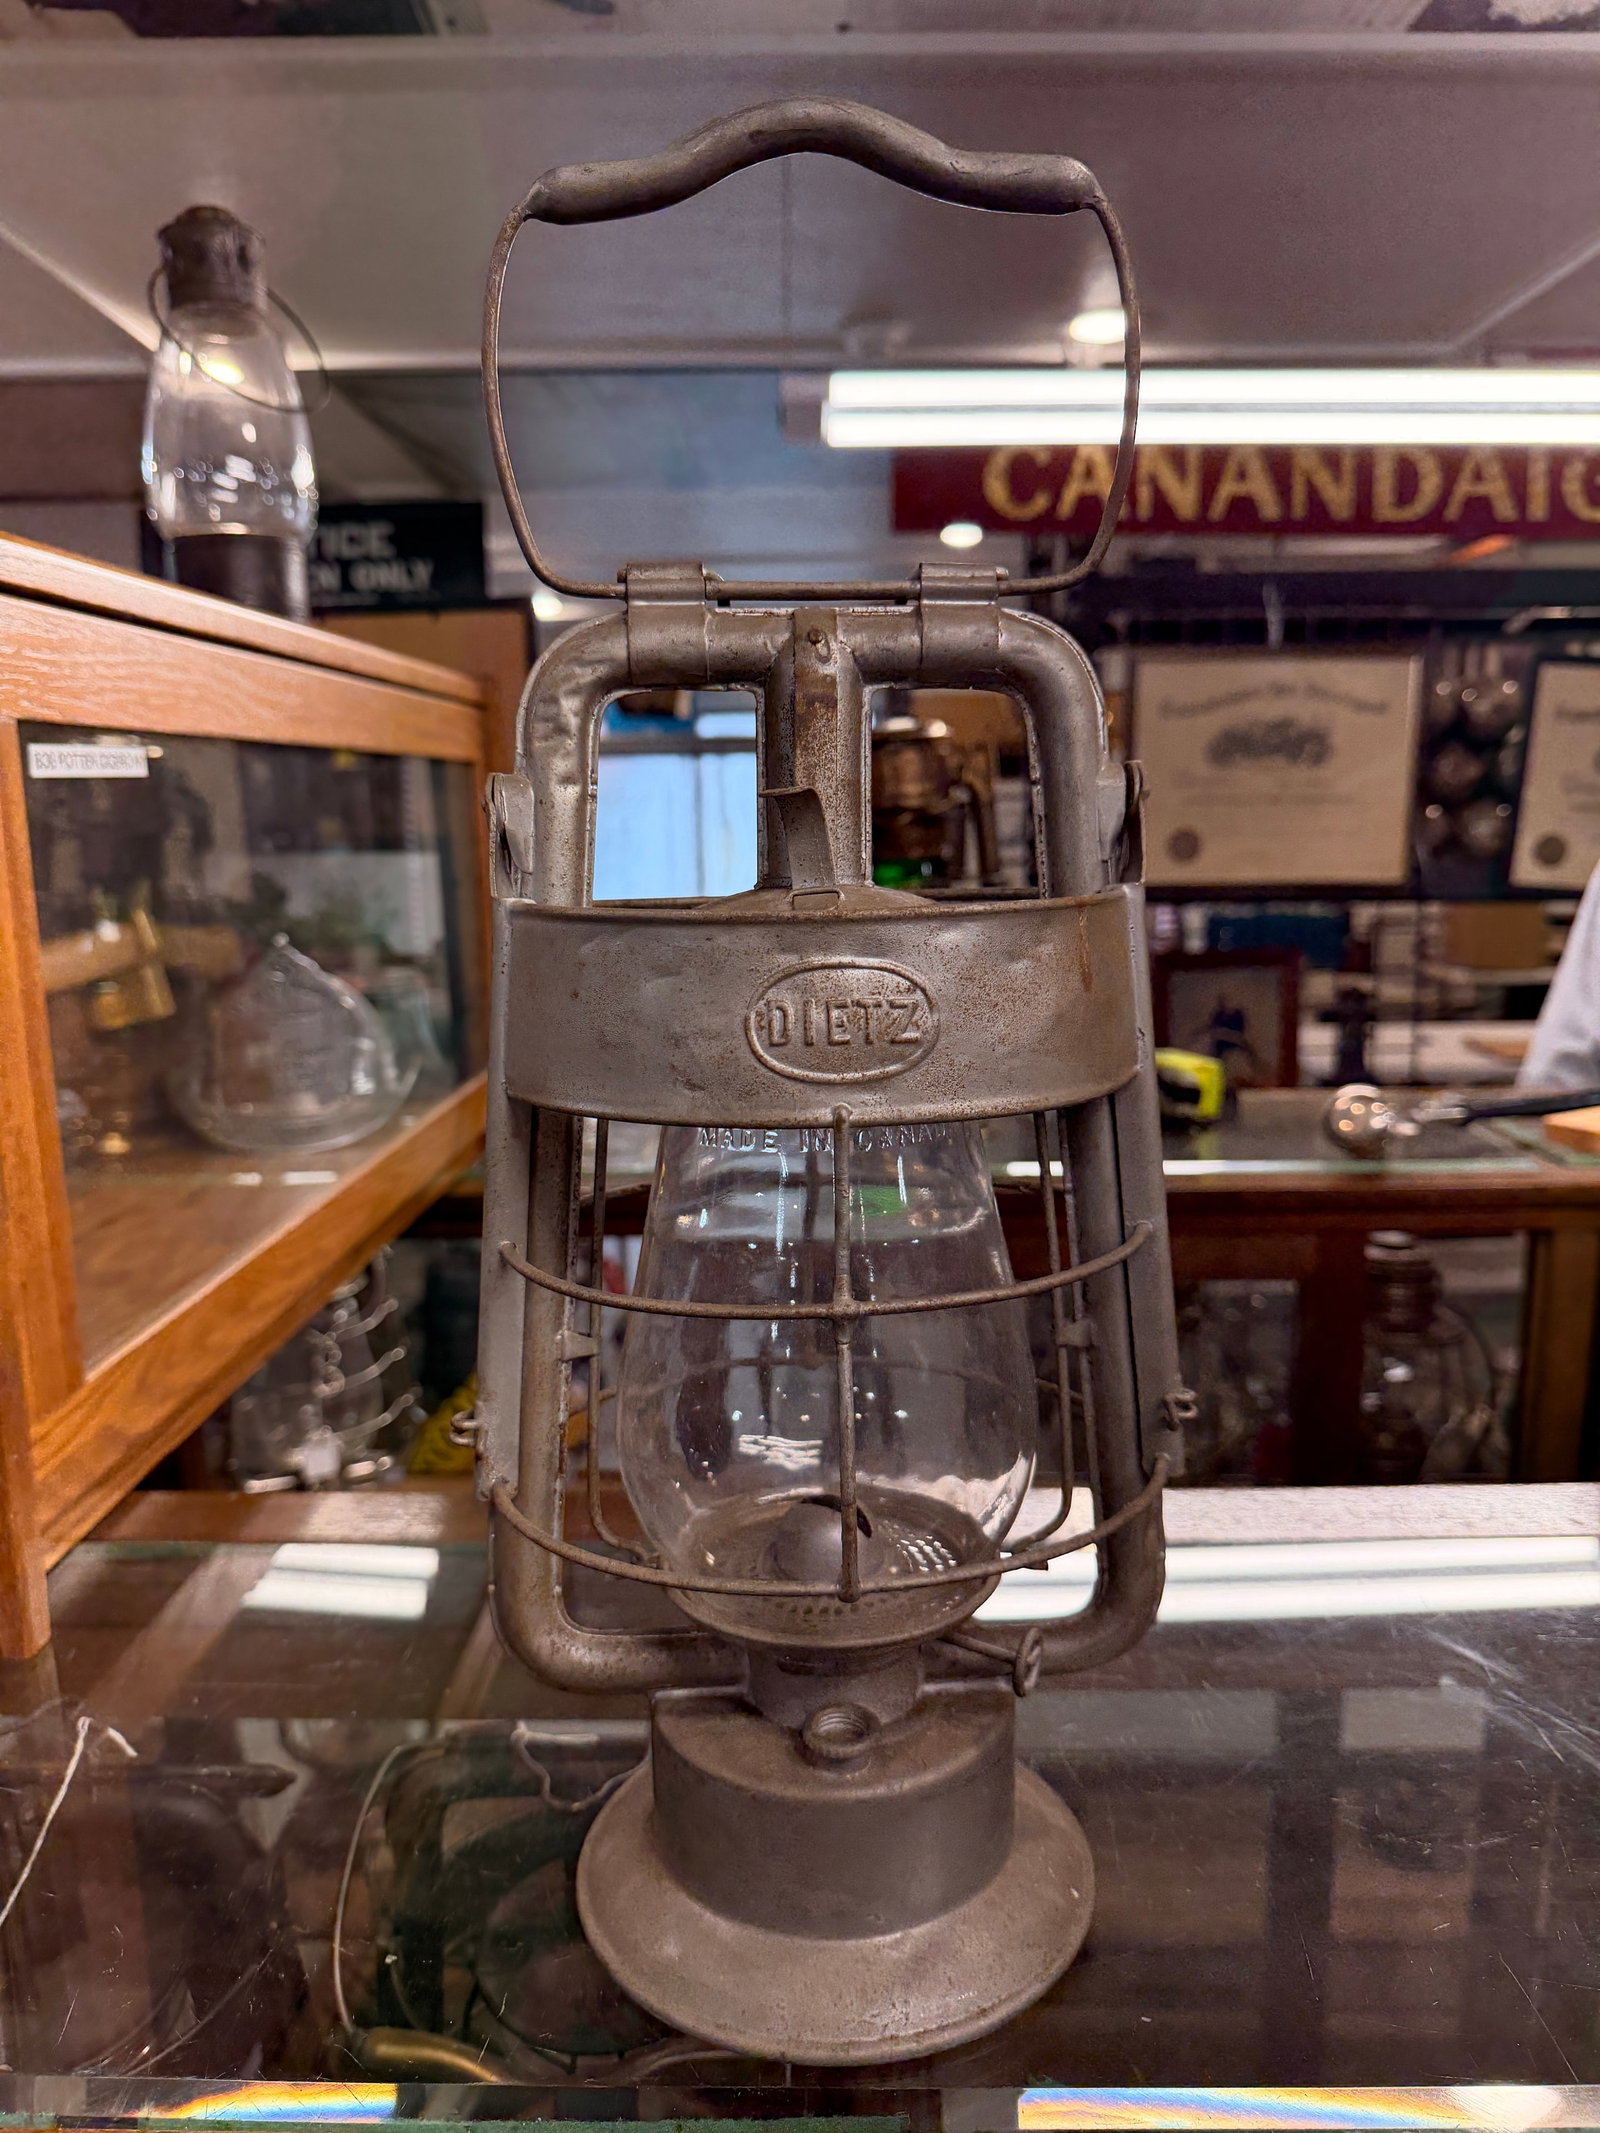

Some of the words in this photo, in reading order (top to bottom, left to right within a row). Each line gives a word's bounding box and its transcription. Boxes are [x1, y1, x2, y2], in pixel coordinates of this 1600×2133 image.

[349, 557, 435, 592] ONLY
[766, 996, 921, 1046] DIETZ
[699, 1128, 778, 1153] MADE
[800, 1128, 833, 1153] IN
